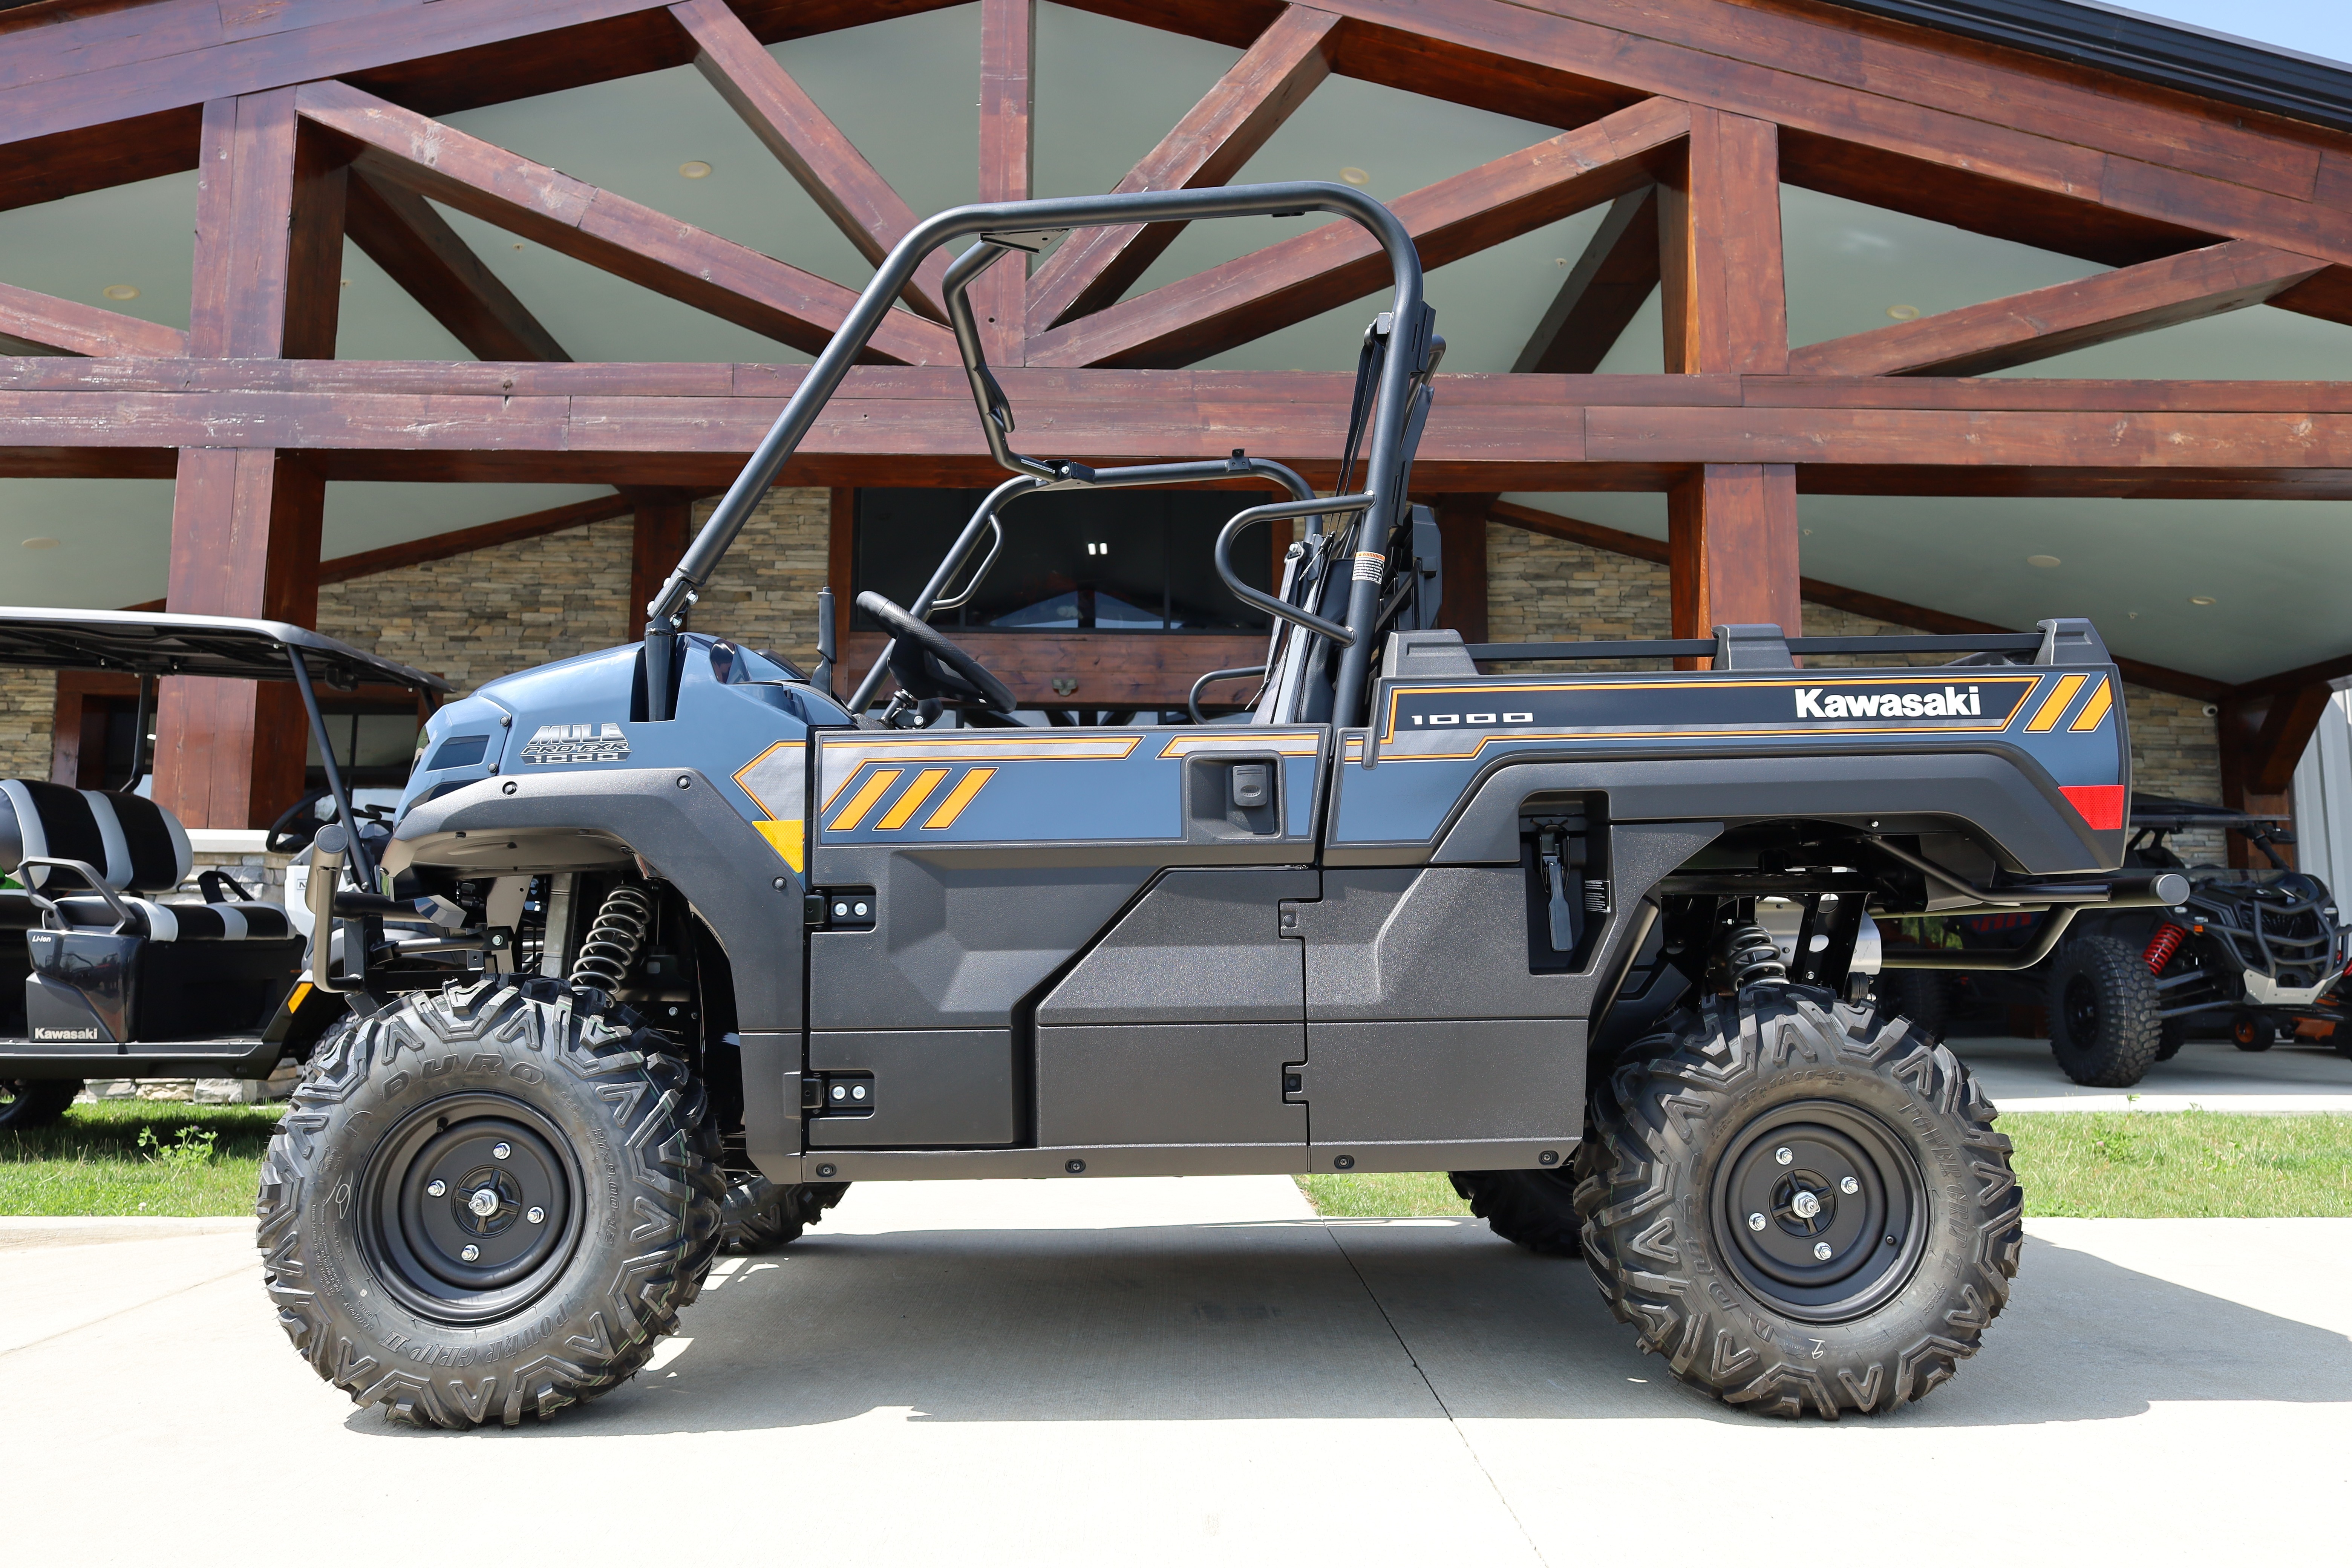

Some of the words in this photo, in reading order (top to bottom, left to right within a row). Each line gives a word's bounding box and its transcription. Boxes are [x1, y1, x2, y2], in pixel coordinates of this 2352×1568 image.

[1795, 686, 1981, 718] Kawasaki
[1411, 712, 1533, 725] 1000
[520, 742, 630, 755] PRO-FXR
[527, 723, 627, 746] MULE
[534, 753, 618, 763] 1000
[35, 1028, 98, 1039] Kawasaki
[382, 1053, 545, 1099] DURO
[1738, 1070, 1848, 1107] 27x11.00-12
[1897, 1102, 1962, 1178] POWER
[1946, 1185, 1969, 1248] GRIP
[1683, 1152, 1741, 1311] DURO
[486, 1303, 570, 1363] POWER
[410, 1343, 477, 1367] GRIP
